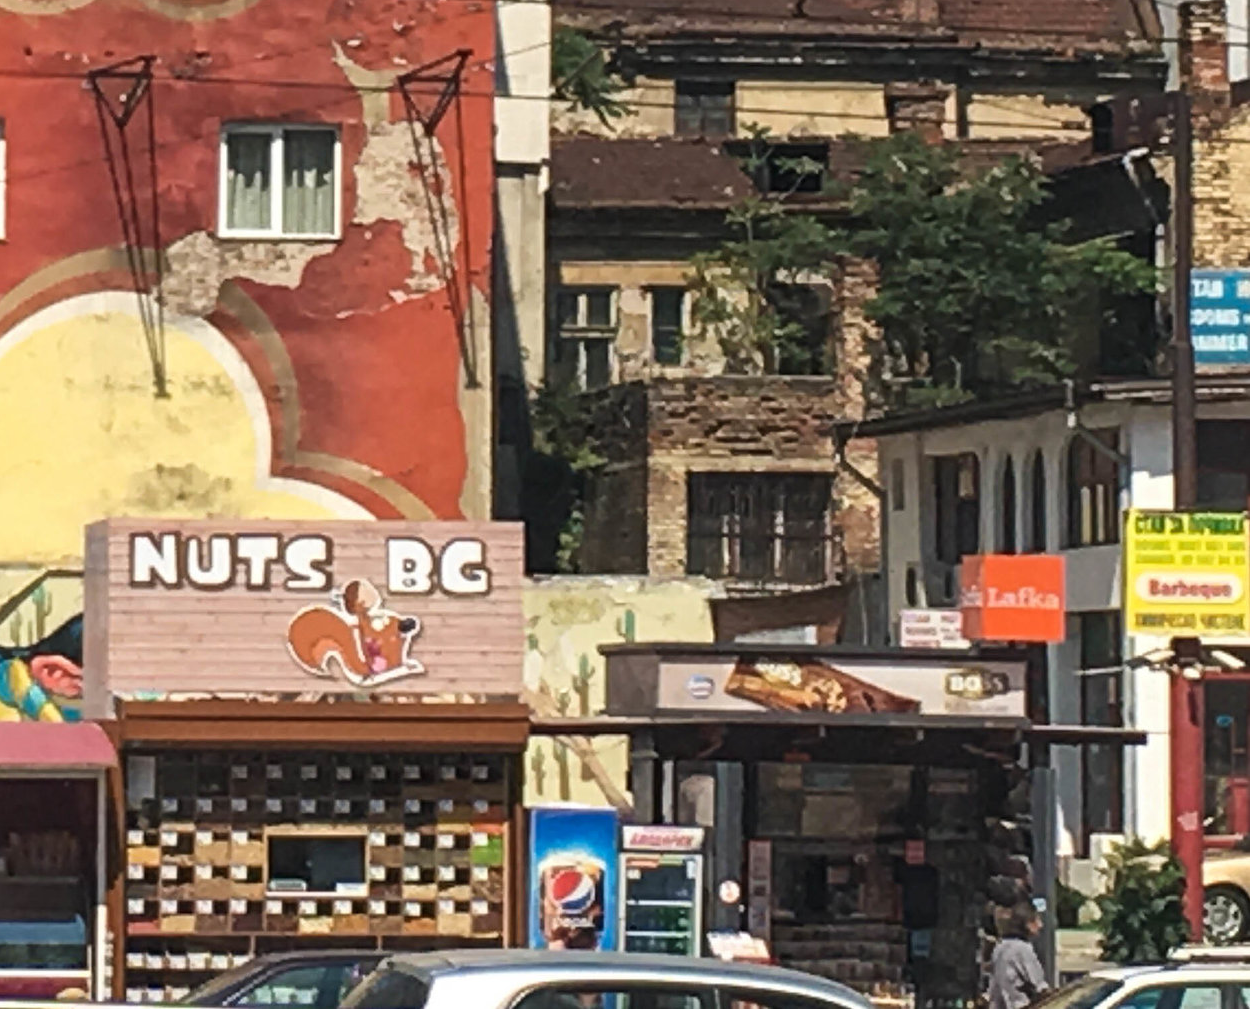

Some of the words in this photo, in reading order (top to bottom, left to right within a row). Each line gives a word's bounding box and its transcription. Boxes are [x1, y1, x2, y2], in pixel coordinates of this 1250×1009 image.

[130, 532, 334, 591] NUTS
[385, 536, 492, 595] BG
[987, 586, 1061, 609] Lafka
